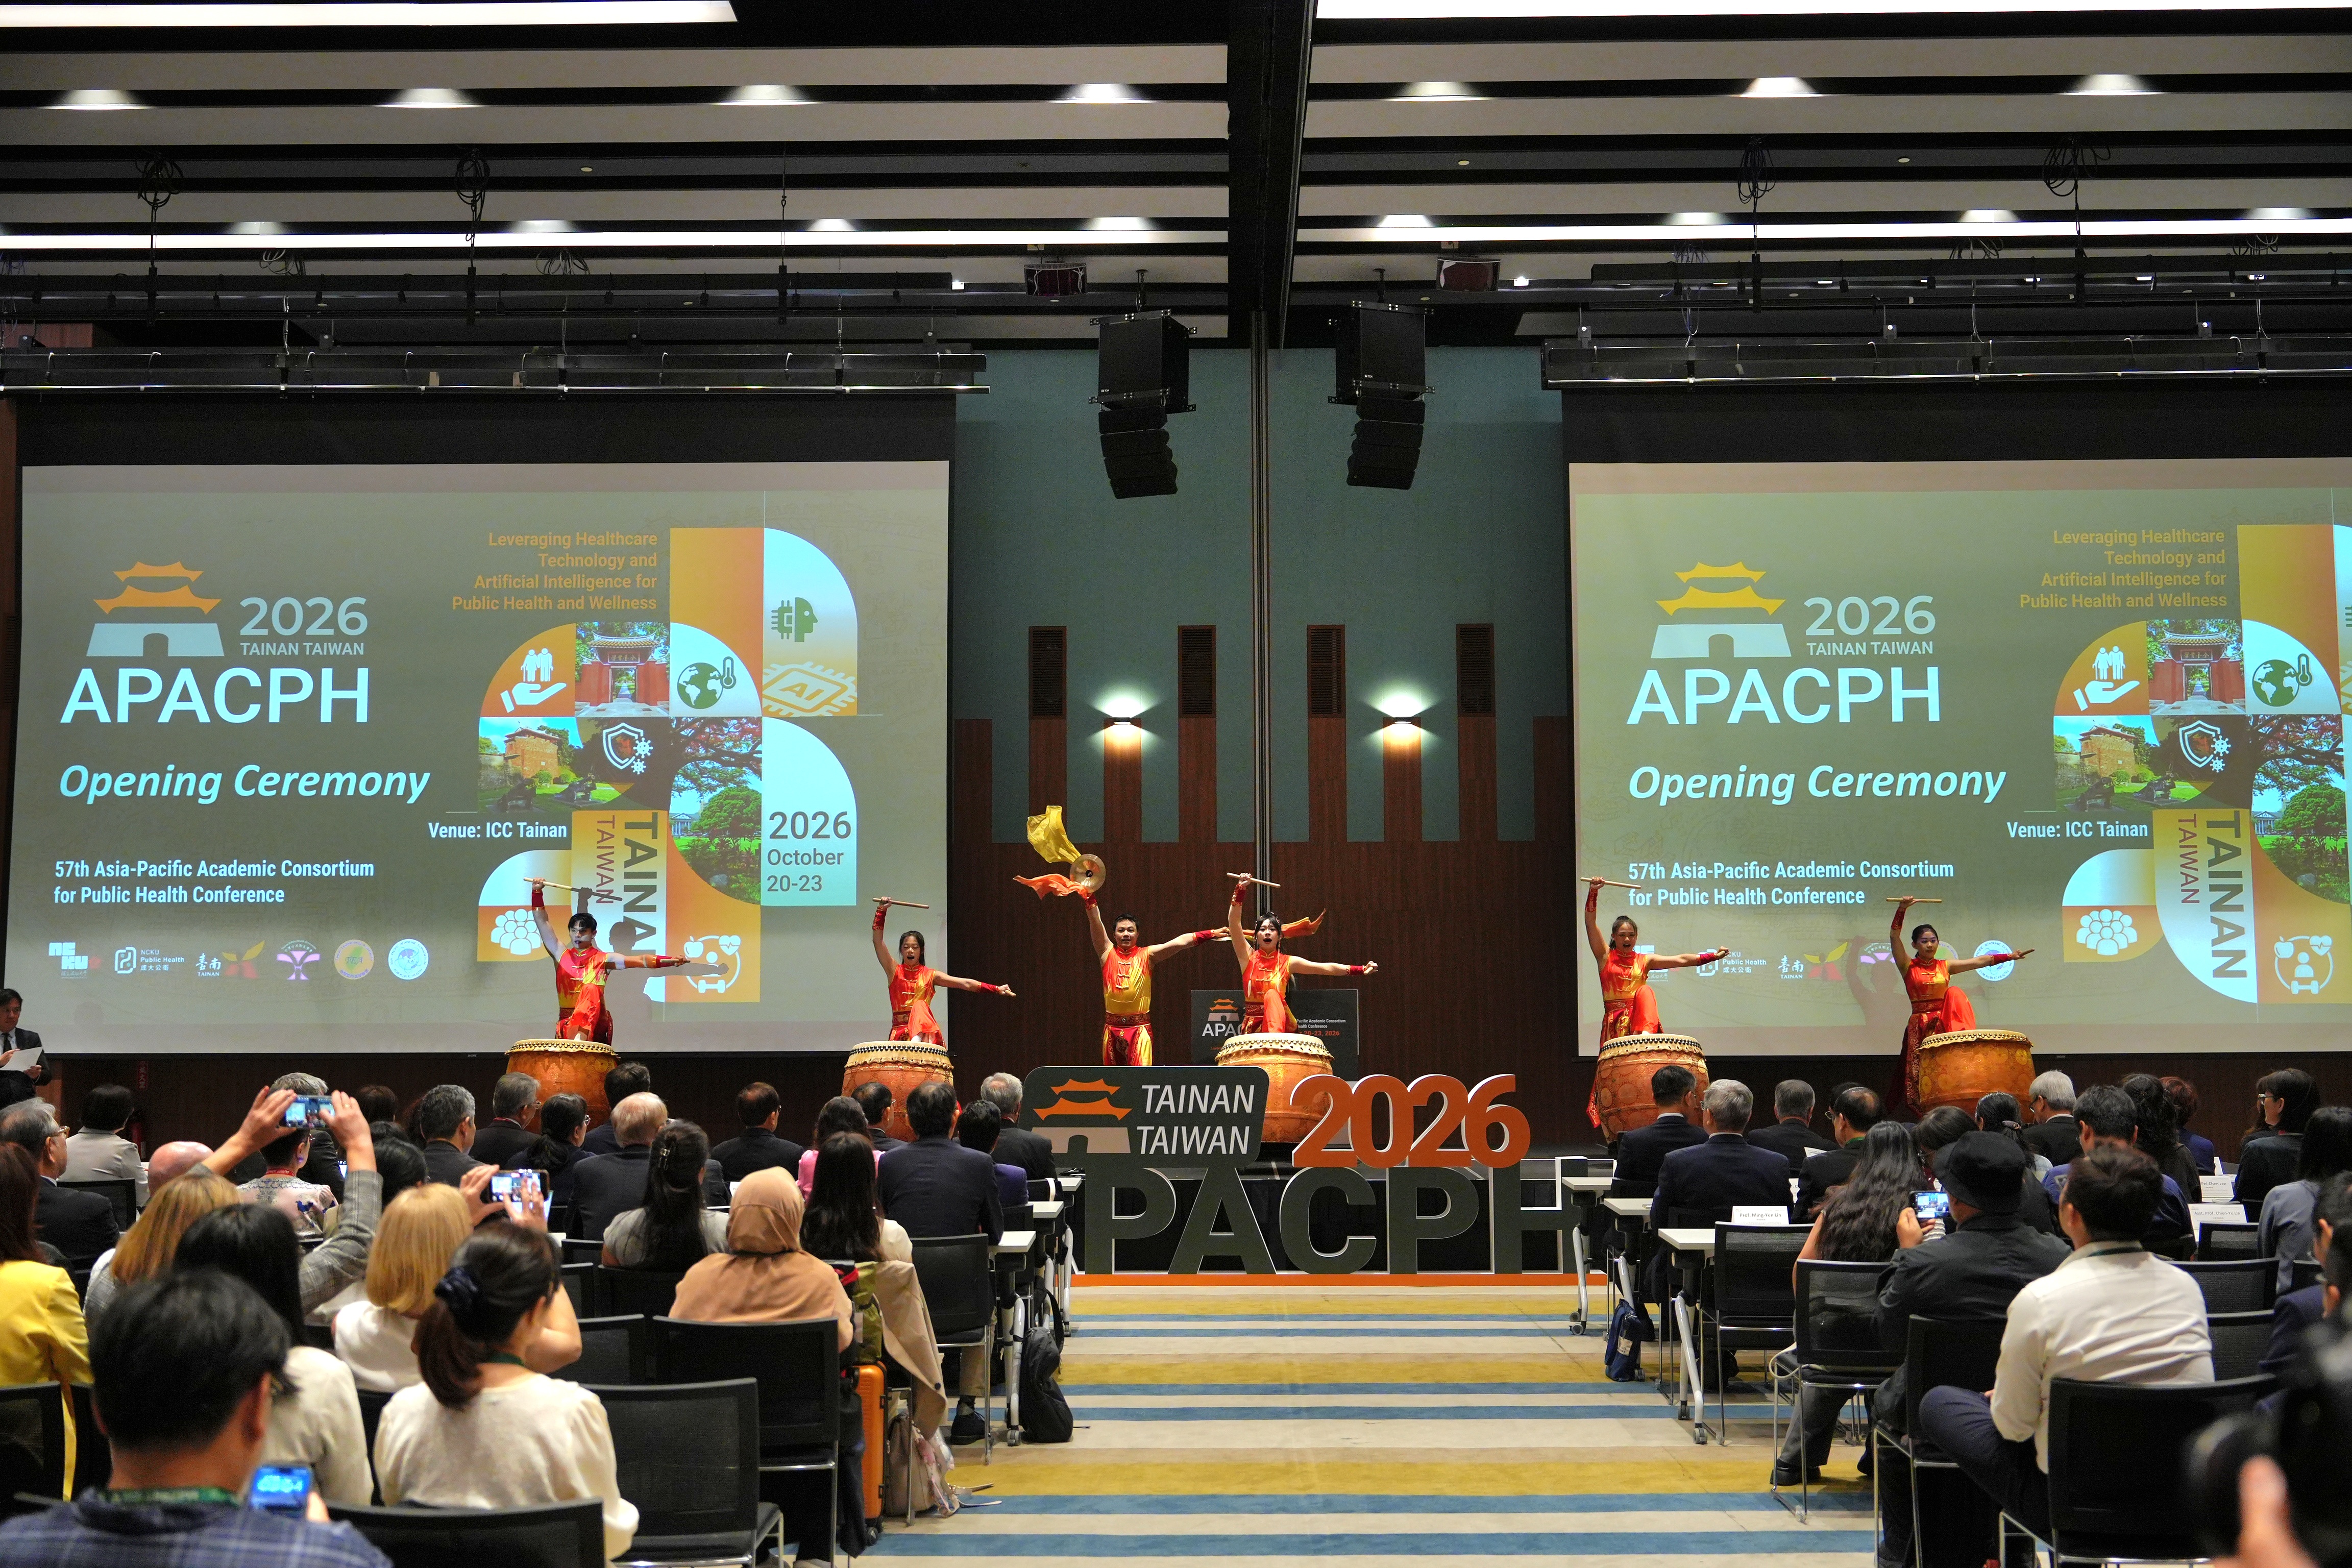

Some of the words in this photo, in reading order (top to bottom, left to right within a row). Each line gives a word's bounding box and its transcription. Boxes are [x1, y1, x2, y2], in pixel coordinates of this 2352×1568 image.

[489, 532, 572, 549] Leveraging
[576, 531, 658, 545] Healthcare
[2054, 530, 2138, 547] Leveraging
[2142, 529, 2225, 544] Healthcare
[538, 553, 625, 570] Technology
[630, 552, 657, 567] and
[2104, 550, 2193, 568] Technology
[2198, 549, 2225, 564] and
[475, 574, 539, 588] Artificial
[544, 574, 631, 592] Intelligence
[635, 574, 657, 588] for
[2042, 572, 2106, 587] Artificial
[2112, 572, 2200, 589] Intelligence
[2204, 571, 2226, 585] for
[453, 596, 499, 609] Public
[504, 596, 553, 610] Health
[557, 596, 584, 609] and
[590, 595, 657, 609] Wellness
[2020, 594, 2067, 608] Public
[2072, 593, 2122, 607] Health
[2126, 593, 2153, 607] and
[2158, 593, 2227, 606] Wellness
[240, 597, 368, 635] 2026
[1804, 596, 1935, 635] 2026
[240, 643, 299, 655] TAINAN
[303, 643, 363, 655] TAIWAN
[1807, 642, 1866, 655] TAINAN
[1871, 642, 1932, 654] TAIWAN
[61, 668, 369, 723] APACPH
[778, 682, 824, 701] AI
[1627, 667, 1940, 724] APACPH
[60, 765, 222, 804] Opening
[235, 765, 430, 803] Ceremony
[1630, 765, 1795, 806] Opening
[1808, 766, 2006, 803] Ceremony
[428, 823, 480, 838] Venue:
[486, 822, 512, 838] ICC
[517, 822, 567, 837] Tainan
[769, 811, 851, 839] 2026
[2007, 822, 2060, 838] Venue:
[2066, 821, 2092, 837] ICC
[2097, 821, 2147, 837] Tainan
[596, 815, 616, 903] TAIWAN
[768, 848, 844, 865] October
[2178, 814, 2200, 903] TAIWAN
[56, 860, 89, 877] 57th
[94, 860, 192, 876] Asia-Pacific
[197, 860, 276, 876] Academic
[281, 860, 374, 876] Consortium
[1629, 862, 1665, 879] 57th
[1671, 862, 1769, 878] Asia-Pacific
[1775, 861, 1854, 877] Academic
[1860, 861, 1953, 877] Consortium
[623, 812, 658, 955] TAINA
[767, 875, 822, 892] 20-23
[54, 886, 76, 903] for
[81, 886, 130, 903] Public
[136, 886, 187, 902] Health
[193, 886, 284, 902] Conference
[1629, 889, 1652, 905] for
[1658, 888, 1708, 905] Public
[1714, 888, 1766, 904] Health
[1772, 887, 1865, 904] Conference
[2206, 810, 2247, 978] TAINAN
[1202, 1023, 1242, 1037] APA
[1142, 1085, 1254, 1113] TAINAN
[1290, 1074, 1531, 1168] 2026
[1137, 1126, 1249, 1154] TAIWAN
[1073, 1156, 1588, 1275] PACPH
